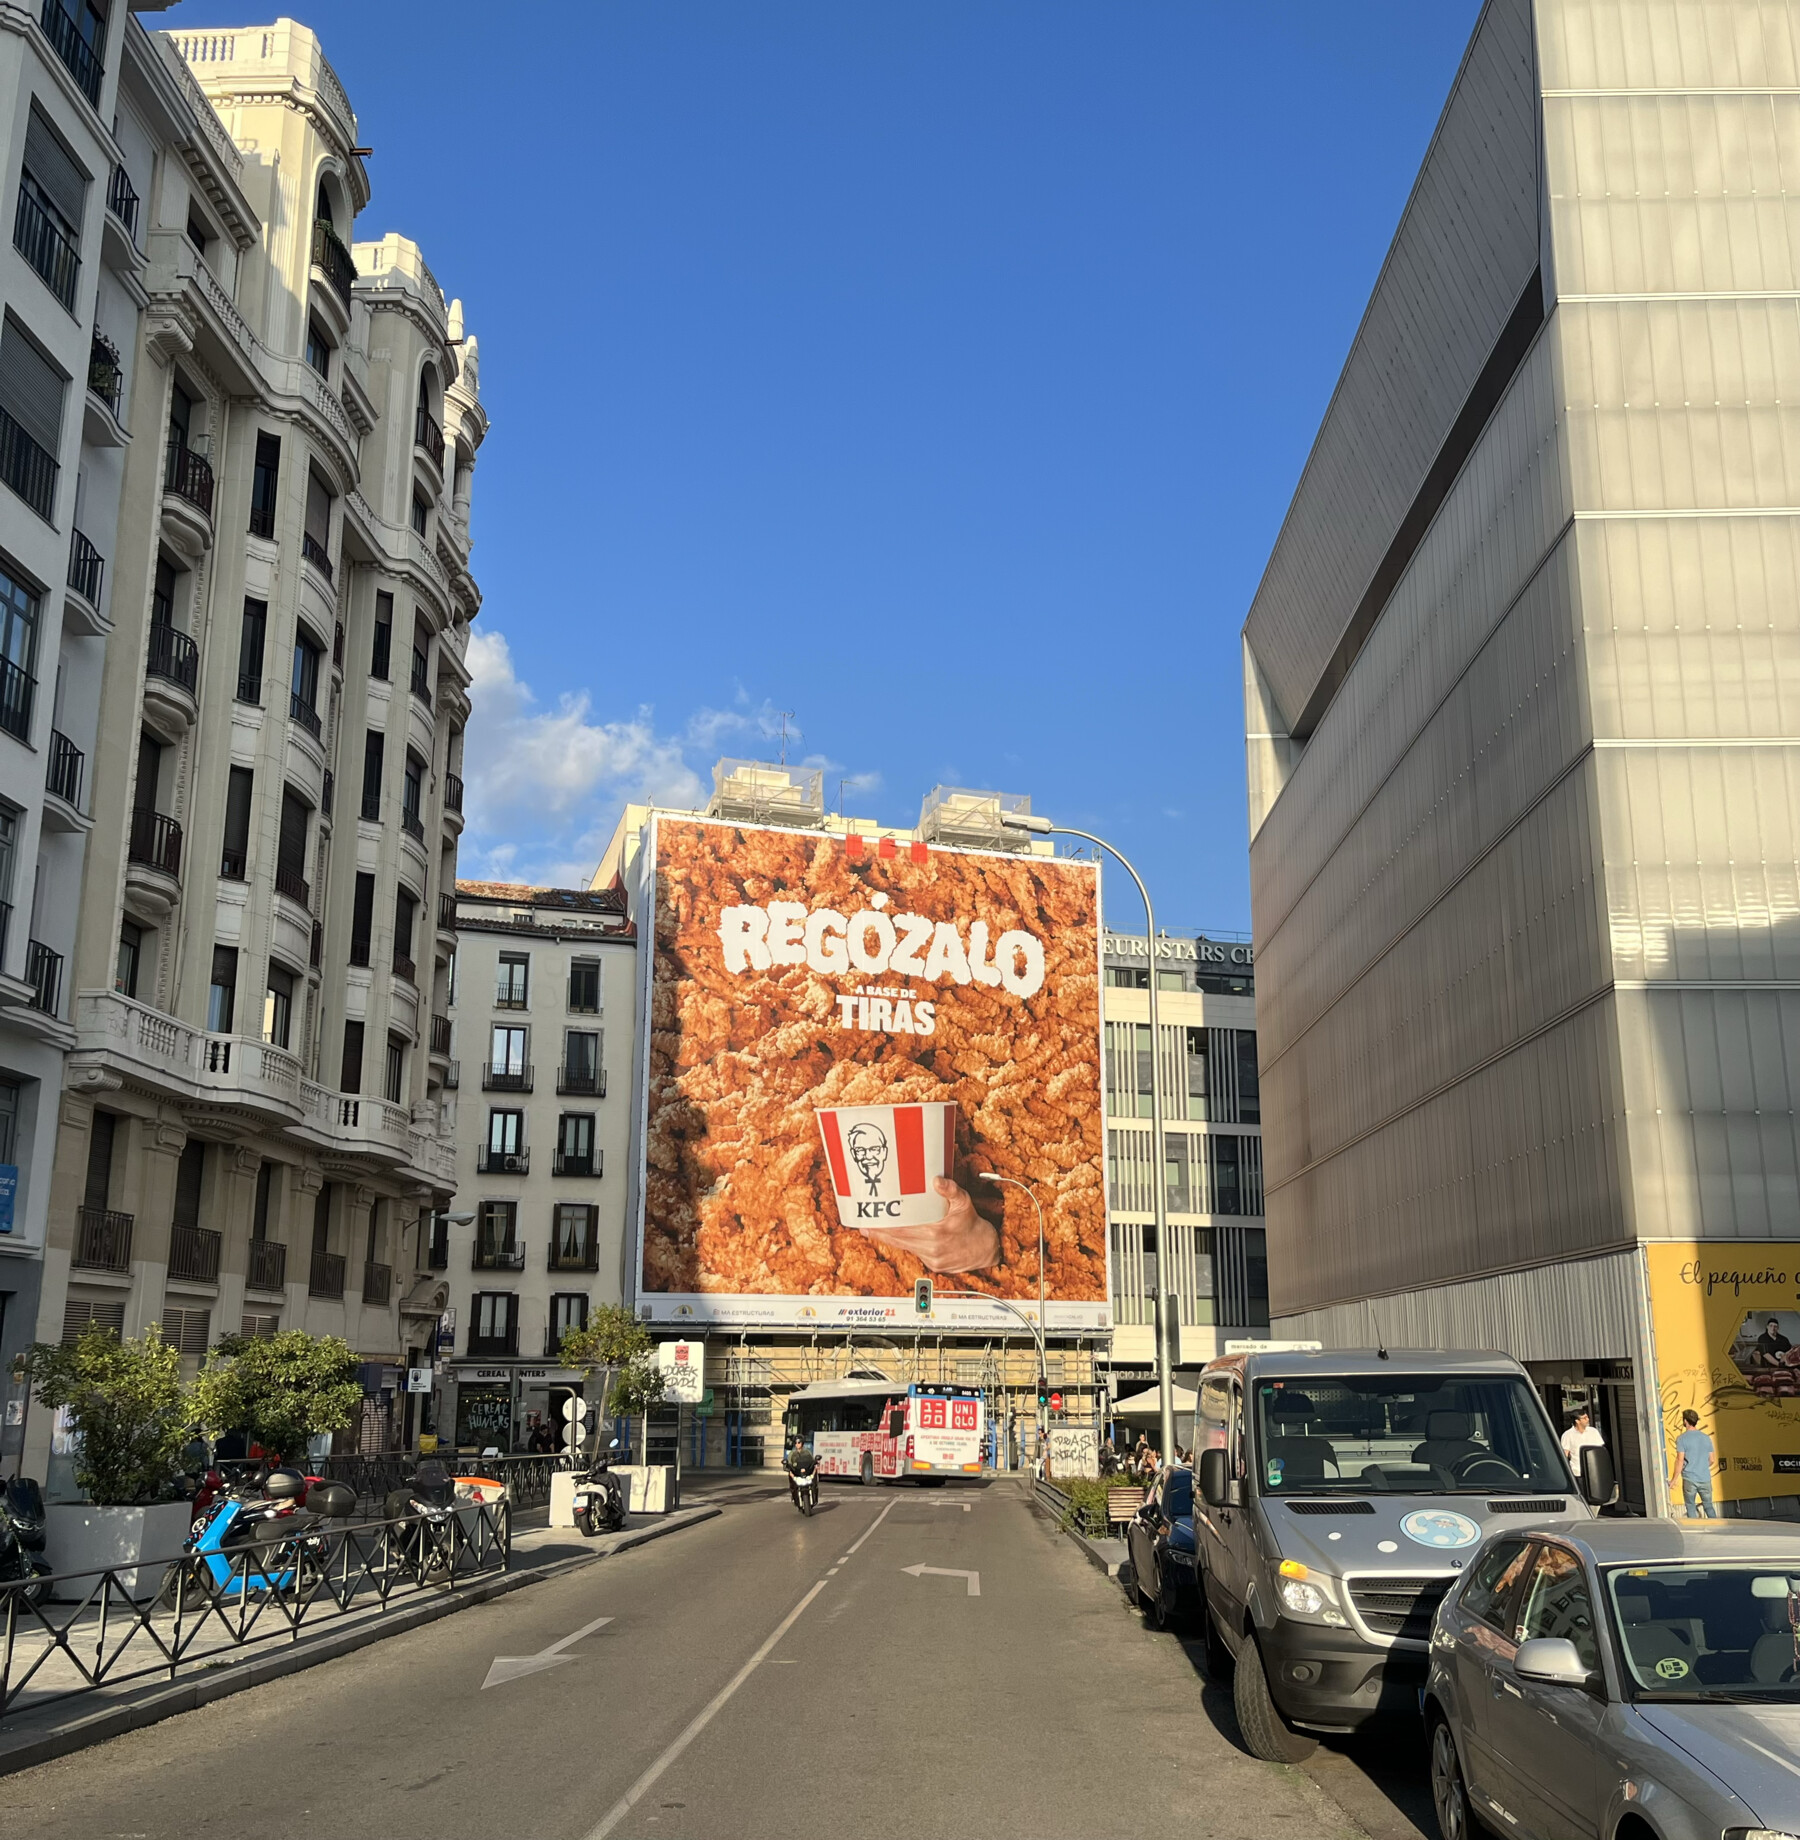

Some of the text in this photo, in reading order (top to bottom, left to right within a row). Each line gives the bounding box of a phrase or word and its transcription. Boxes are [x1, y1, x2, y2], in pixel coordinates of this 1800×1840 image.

[1103, 938, 1225, 962] EUROSTARS
[855, 985, 917, 999] A BASE DE
[836, 995, 935, 1036] TIRAS
[857, 1200, 901, 1218] KFC
[1679, 1260, 1704, 1284] El
[1707, 1267, 1786, 1297] pequeño
[477, 1370, 507, 1378] CEREAL
[472, 1402, 508, 1415] CEREAL
[955, 1404, 973, 1415] UNI
[468, 1414, 510, 1432] HUNTERS
[954, 1416, 975, 1427] QLO
